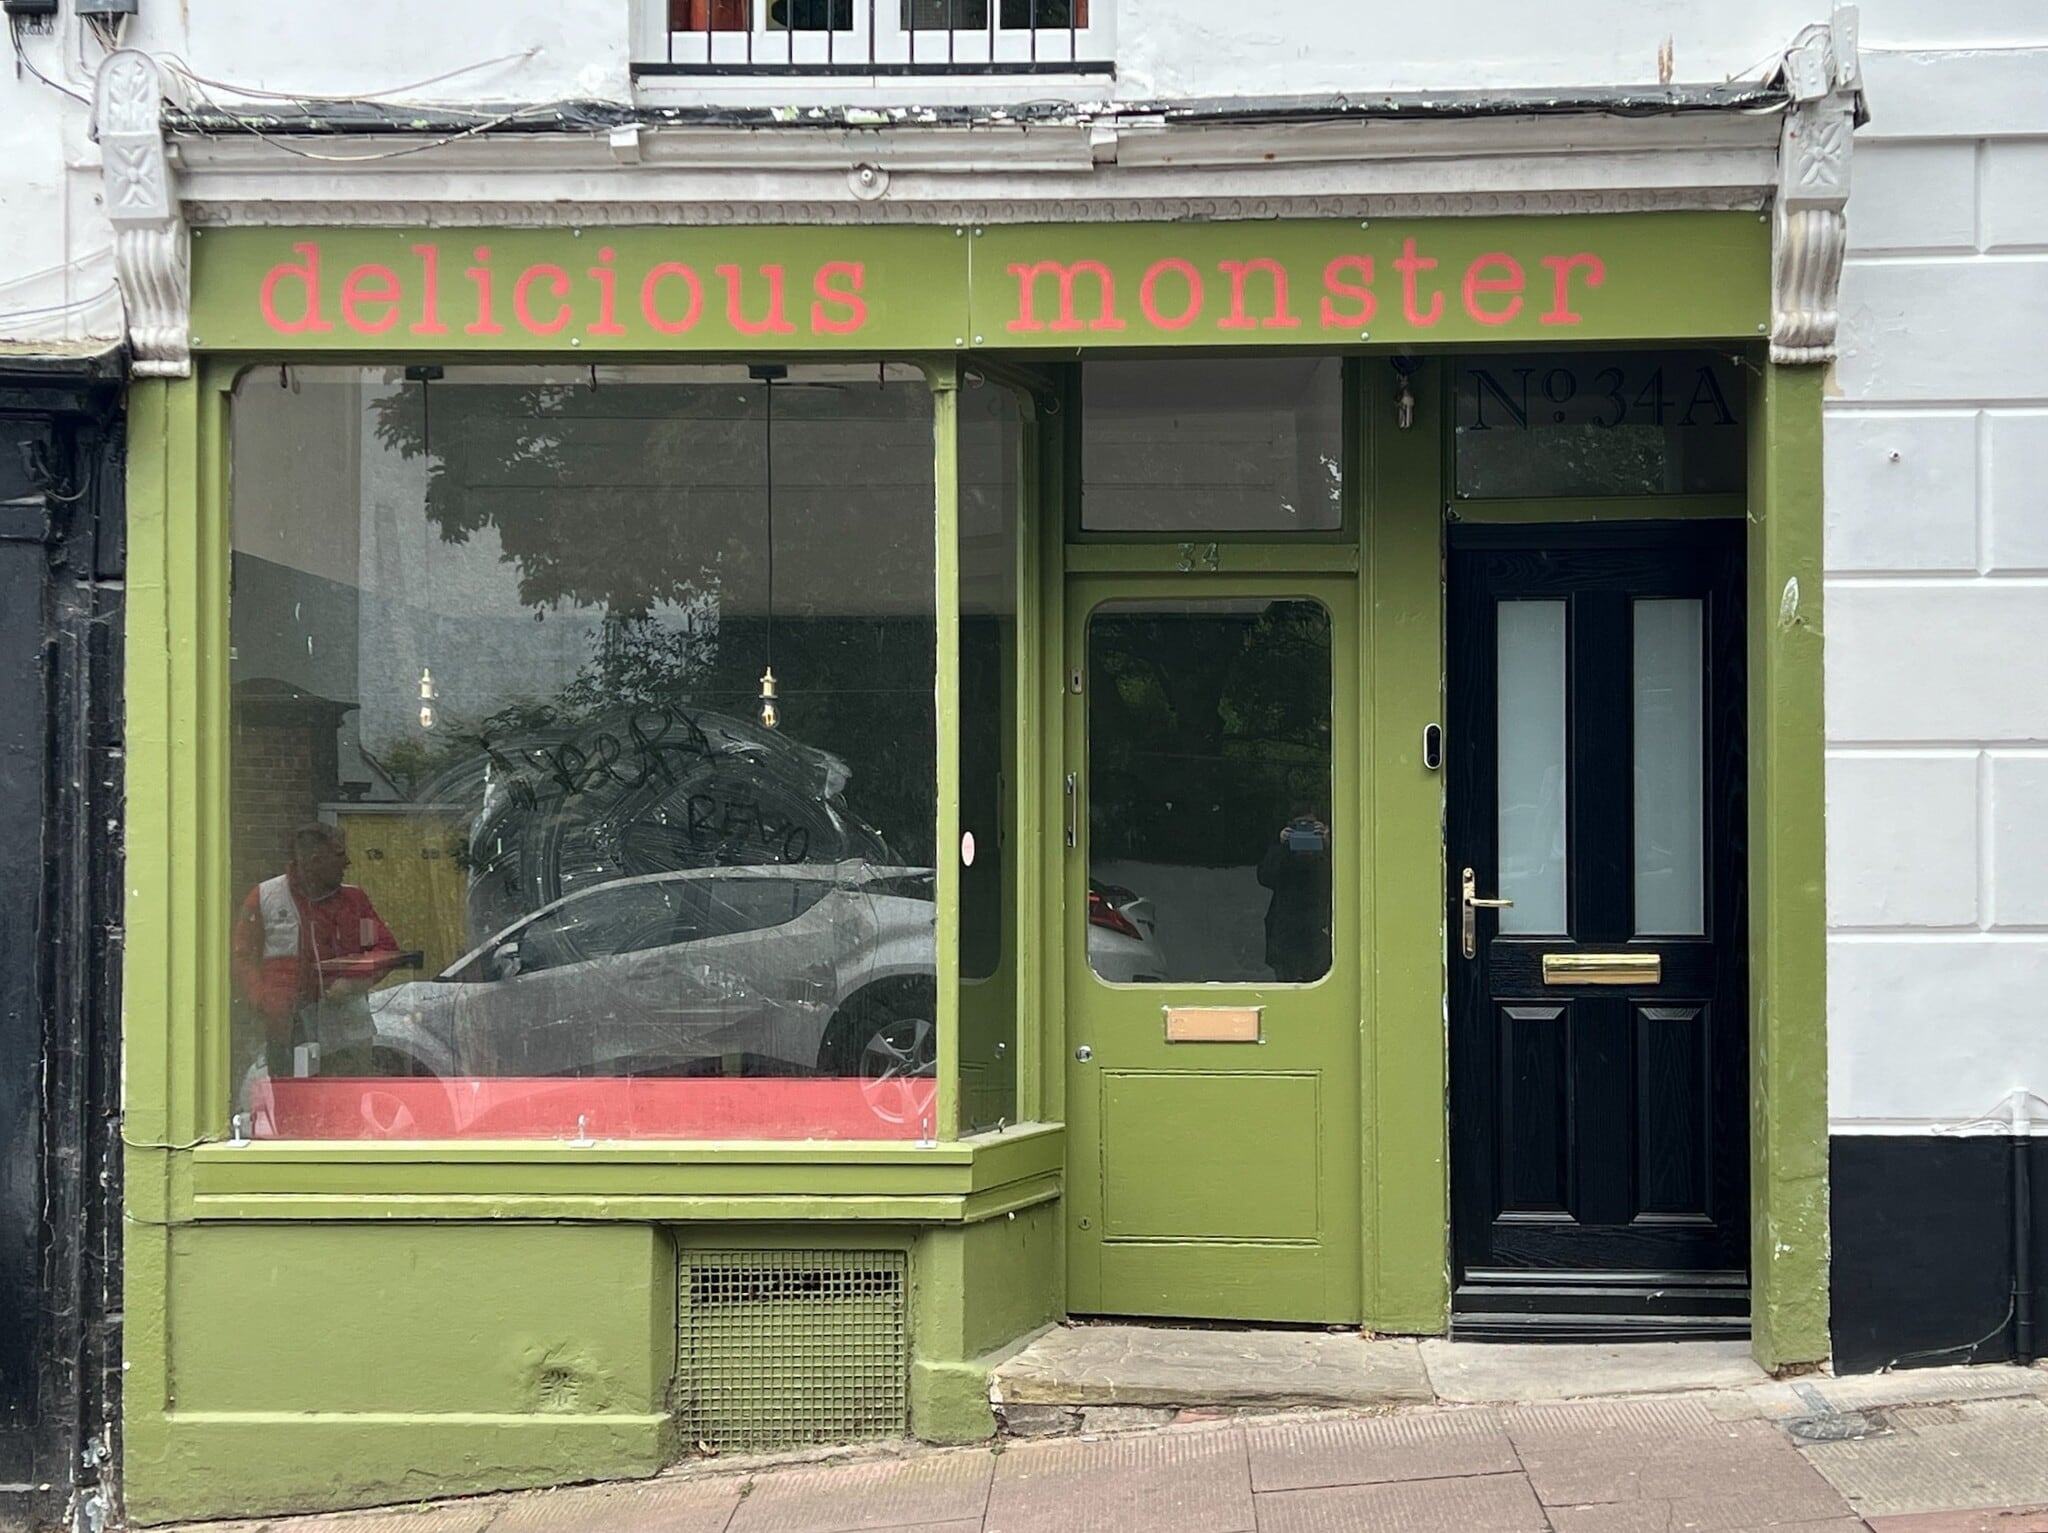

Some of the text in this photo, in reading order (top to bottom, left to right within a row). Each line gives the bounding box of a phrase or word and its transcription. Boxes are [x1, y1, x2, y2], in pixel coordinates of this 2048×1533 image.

[259, 237, 1607, 336] delicious monster
[1593, 365, 1738, 428] 34A
[1176, 542, 1219, 573] 34
